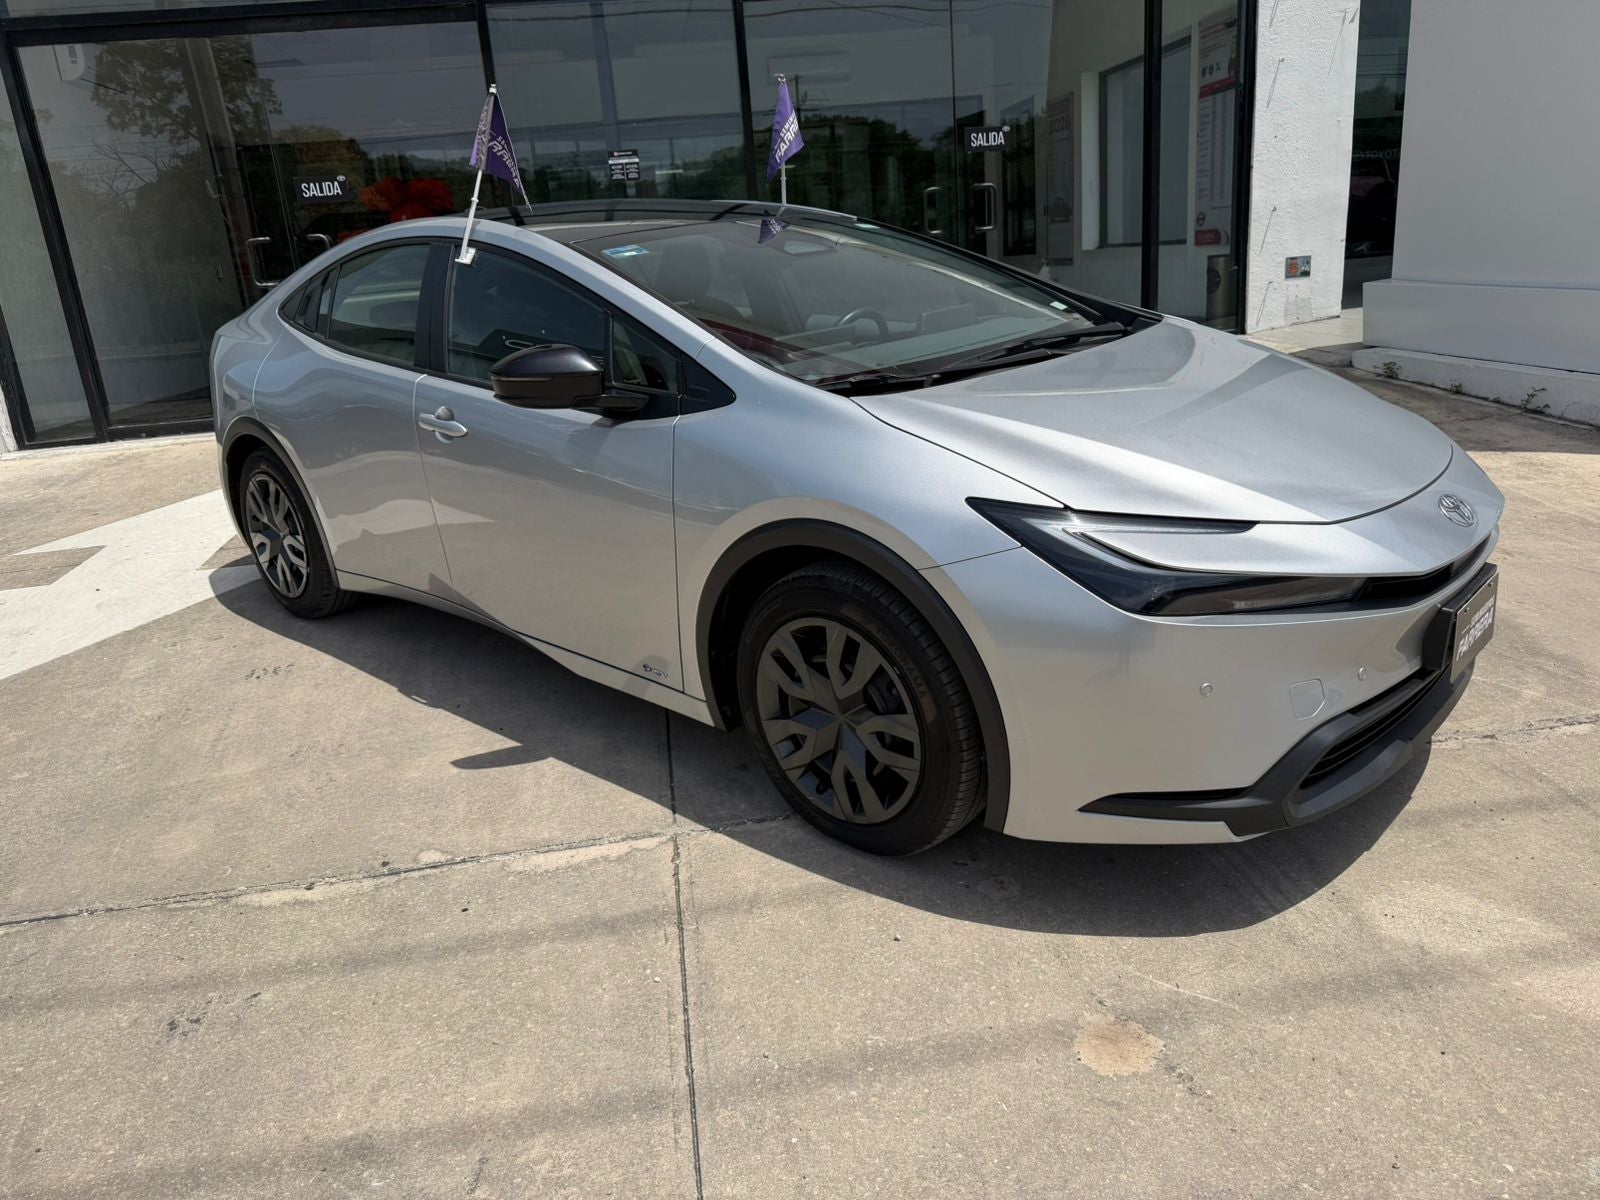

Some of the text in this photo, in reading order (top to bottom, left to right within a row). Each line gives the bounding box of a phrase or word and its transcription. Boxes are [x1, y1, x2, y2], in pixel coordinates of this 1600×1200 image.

[970, 131, 1005, 147] SALIDA
[301, 180, 342, 198] SALIDA
[1456, 606, 1494, 661] FARRERA
